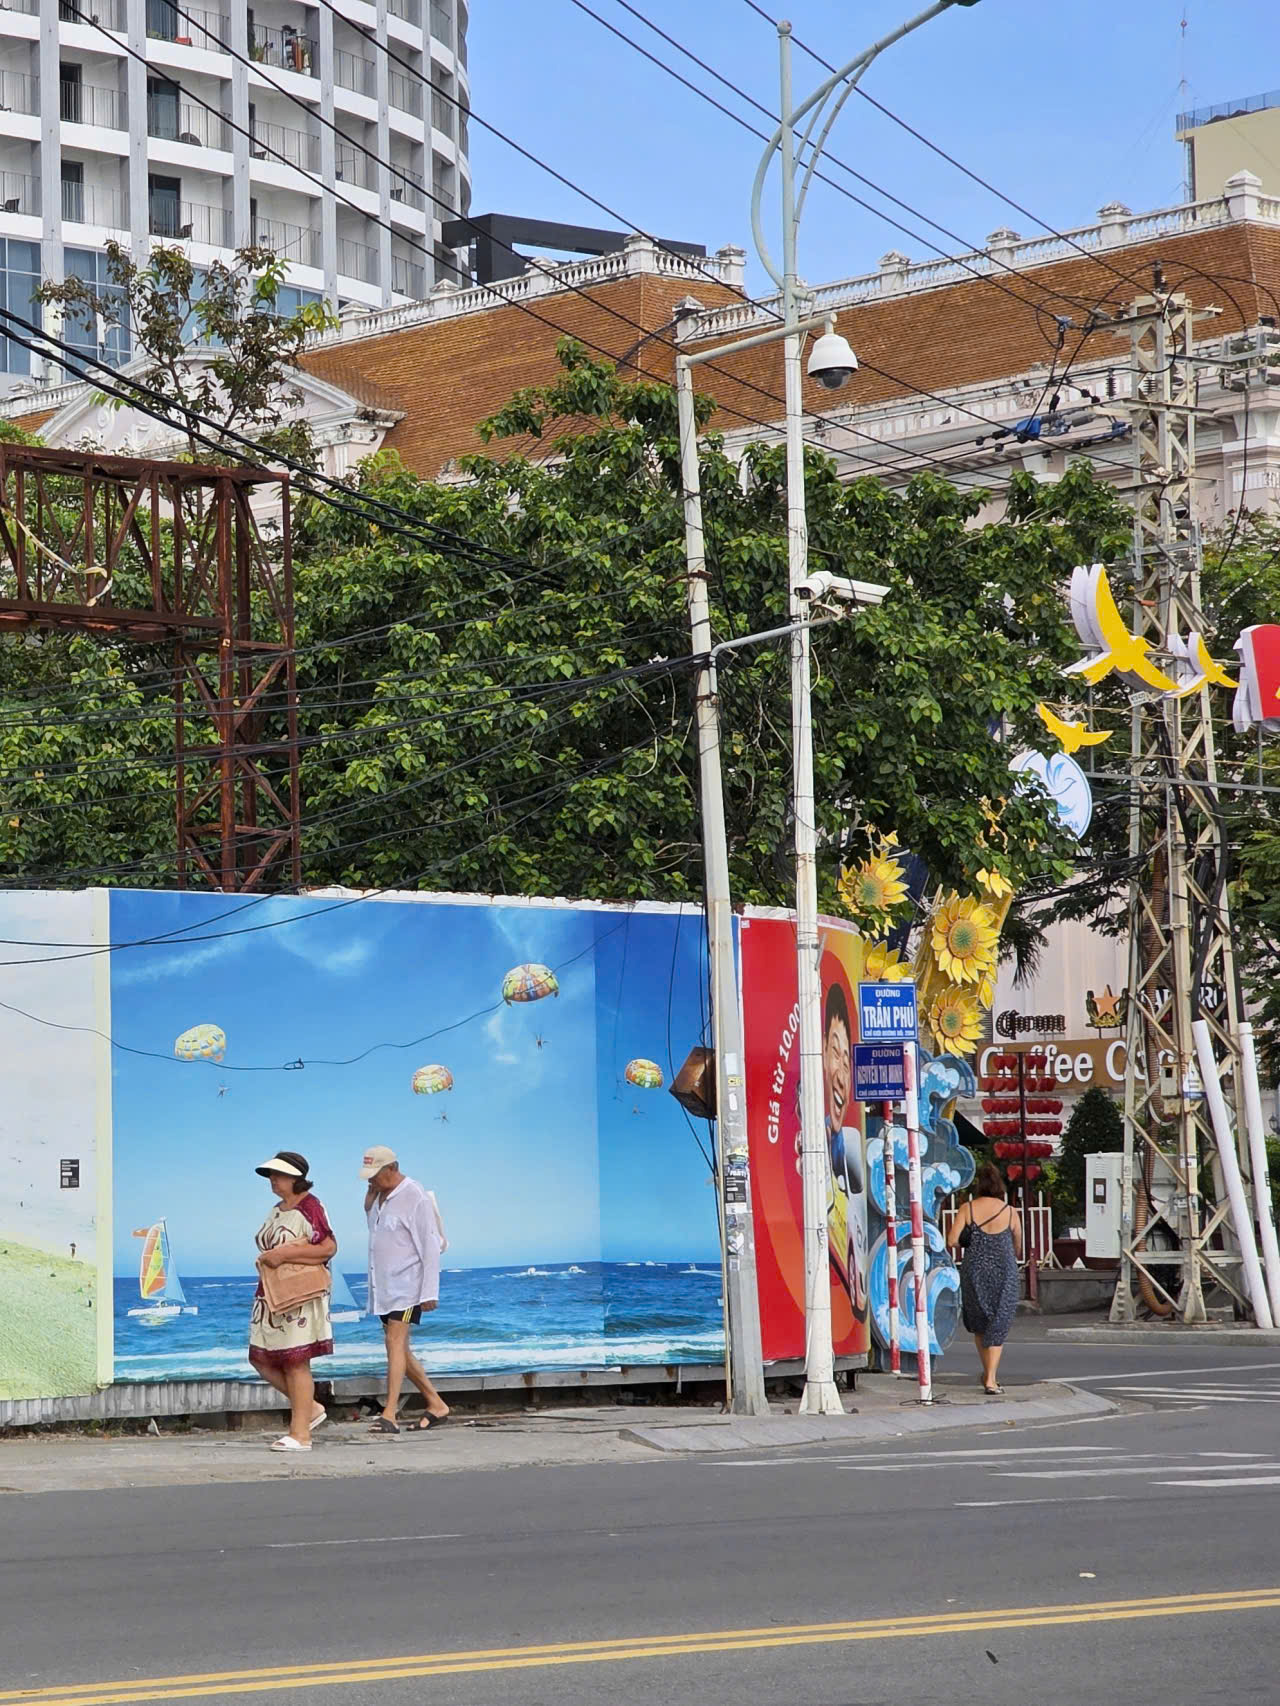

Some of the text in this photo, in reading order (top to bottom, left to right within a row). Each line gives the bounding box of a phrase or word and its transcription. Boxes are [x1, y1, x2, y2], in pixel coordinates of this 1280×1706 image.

[875, 989, 901, 998] ĐƯỜNG
[893, 1001, 914, 1028] PHÚ
[995, 1009, 1066, 1040] Corona
[872, 1048, 901, 1057] ĐƯỜNG
[767, 1100, 780, 1144] Giá
